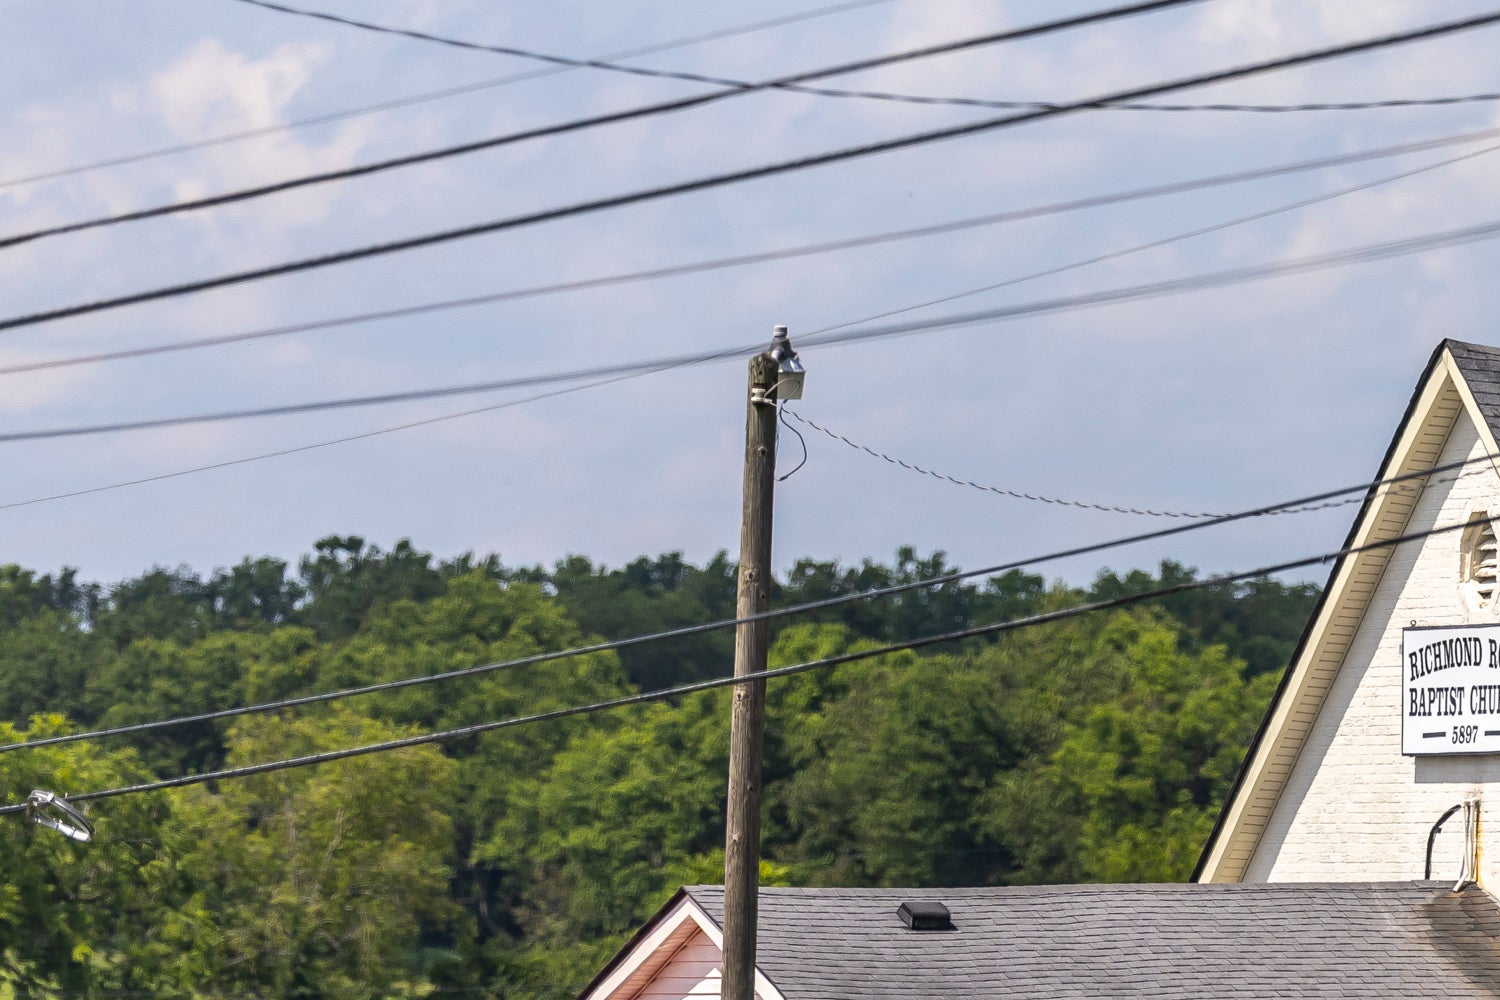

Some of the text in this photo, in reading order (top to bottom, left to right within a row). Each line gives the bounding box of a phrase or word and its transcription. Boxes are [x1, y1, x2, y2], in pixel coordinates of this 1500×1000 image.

[1409, 637, 1482, 681] RICHMOND
[1409, 686, 1465, 716] BAPTIST
[1452, 725, 1478, 744] 5897
